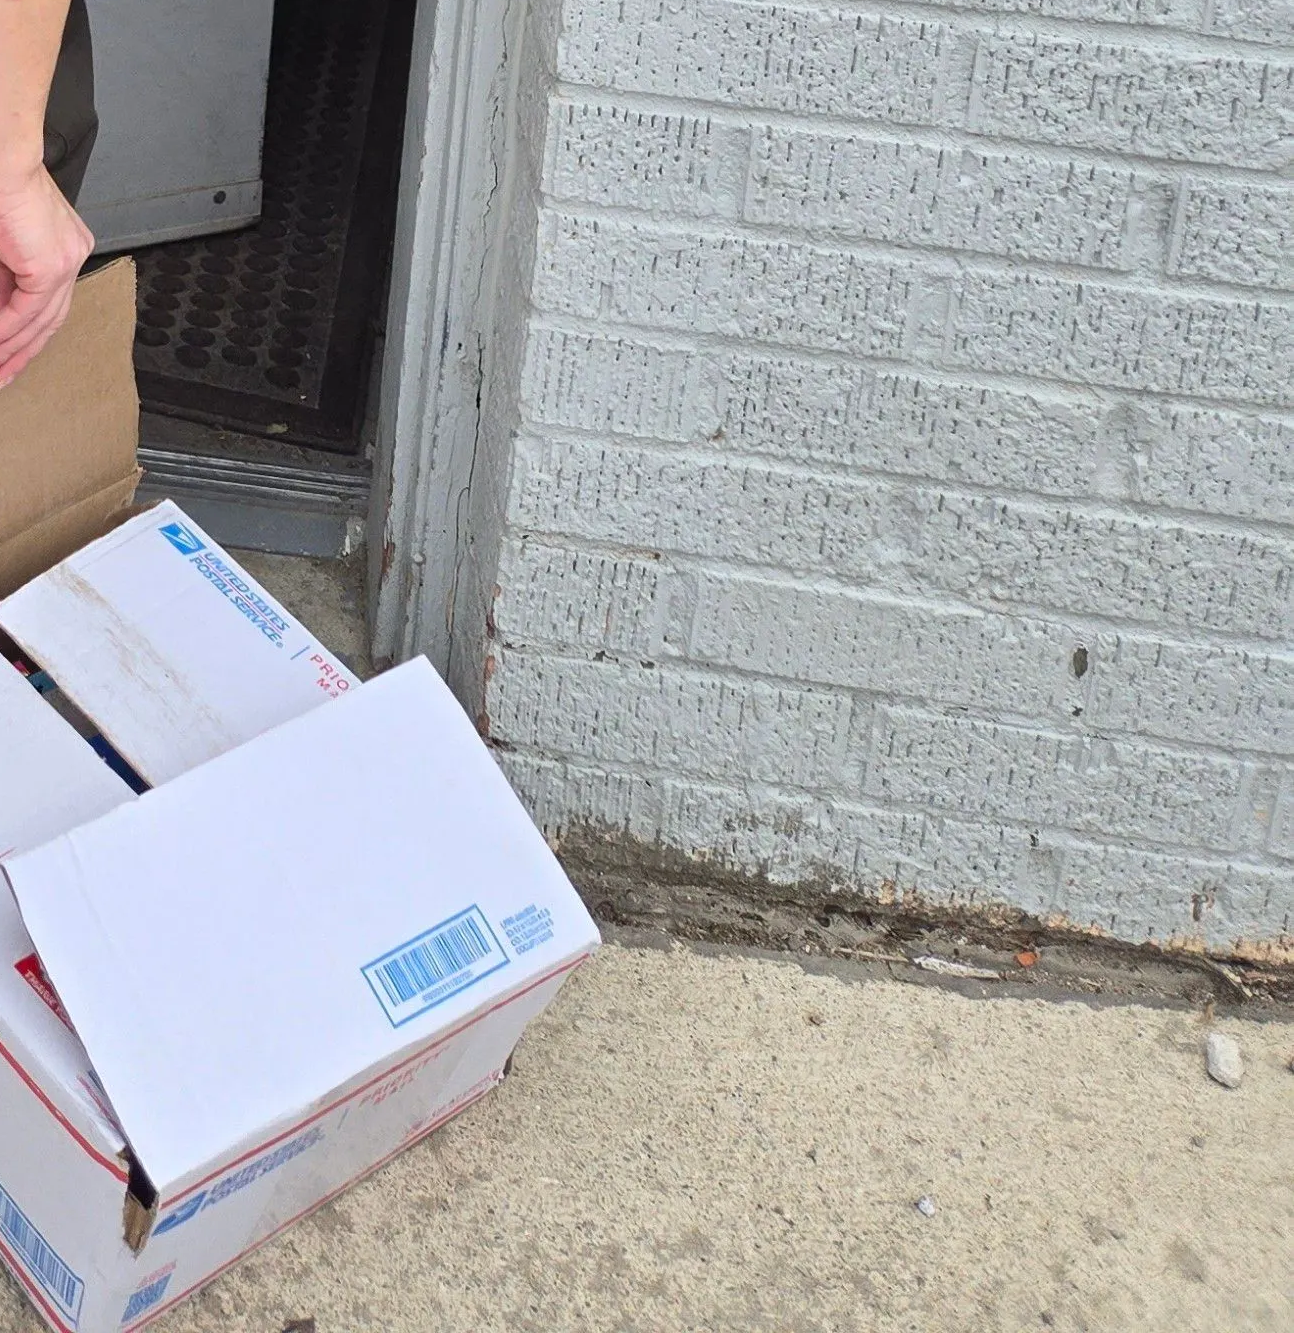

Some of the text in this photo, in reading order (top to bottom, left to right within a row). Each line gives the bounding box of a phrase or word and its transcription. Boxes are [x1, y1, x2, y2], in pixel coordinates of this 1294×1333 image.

[190, 557, 233, 598] POSTAL
[204, 552, 290, 631] UNITED STATES
